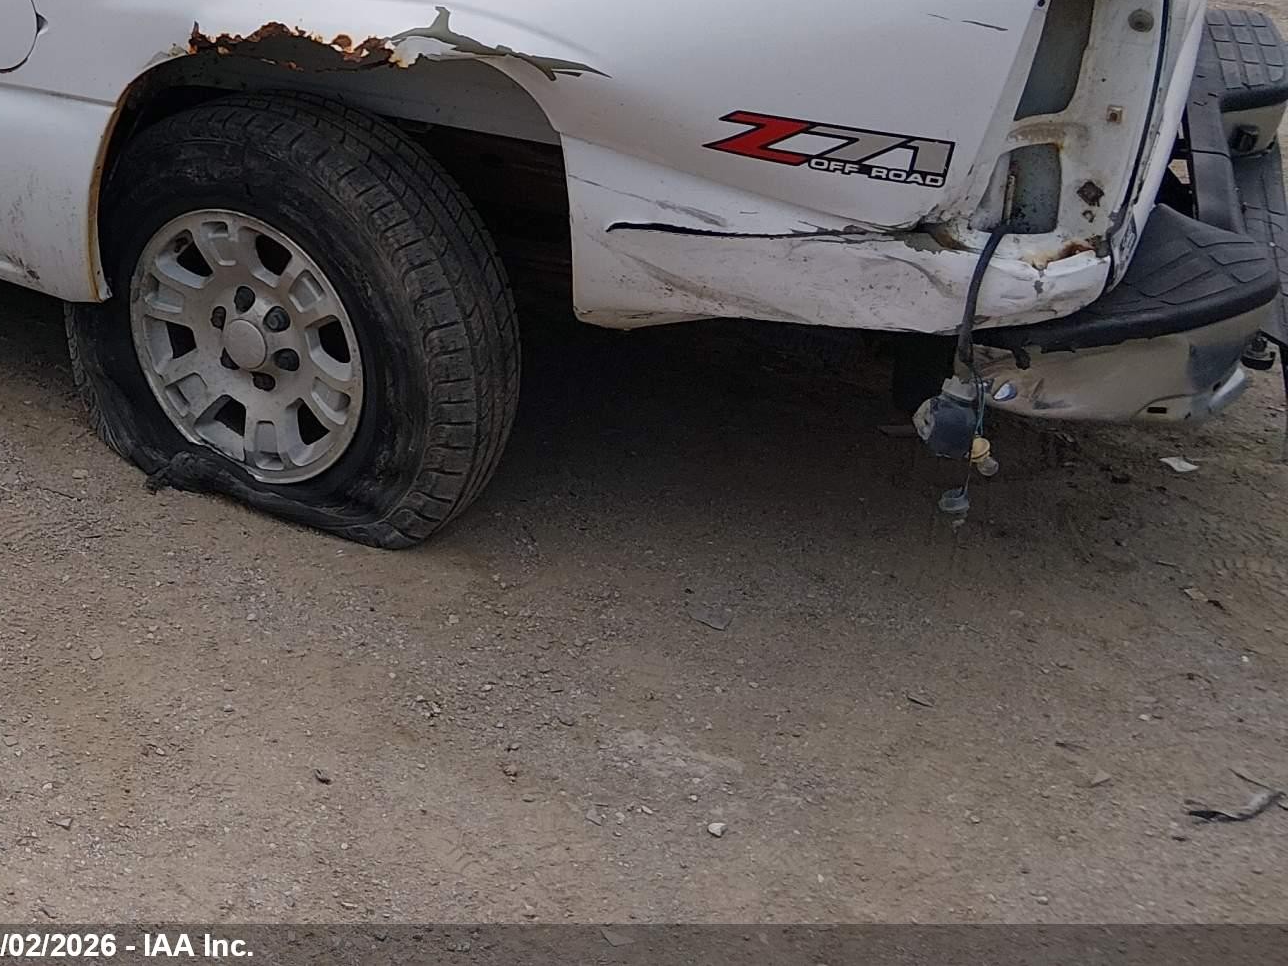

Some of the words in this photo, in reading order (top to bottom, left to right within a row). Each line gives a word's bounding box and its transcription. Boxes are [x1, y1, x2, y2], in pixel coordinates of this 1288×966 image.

[702, 110, 955, 175] Z71
[810, 157, 860, 175] OFF
[870, 166, 944, 188] ROAD
